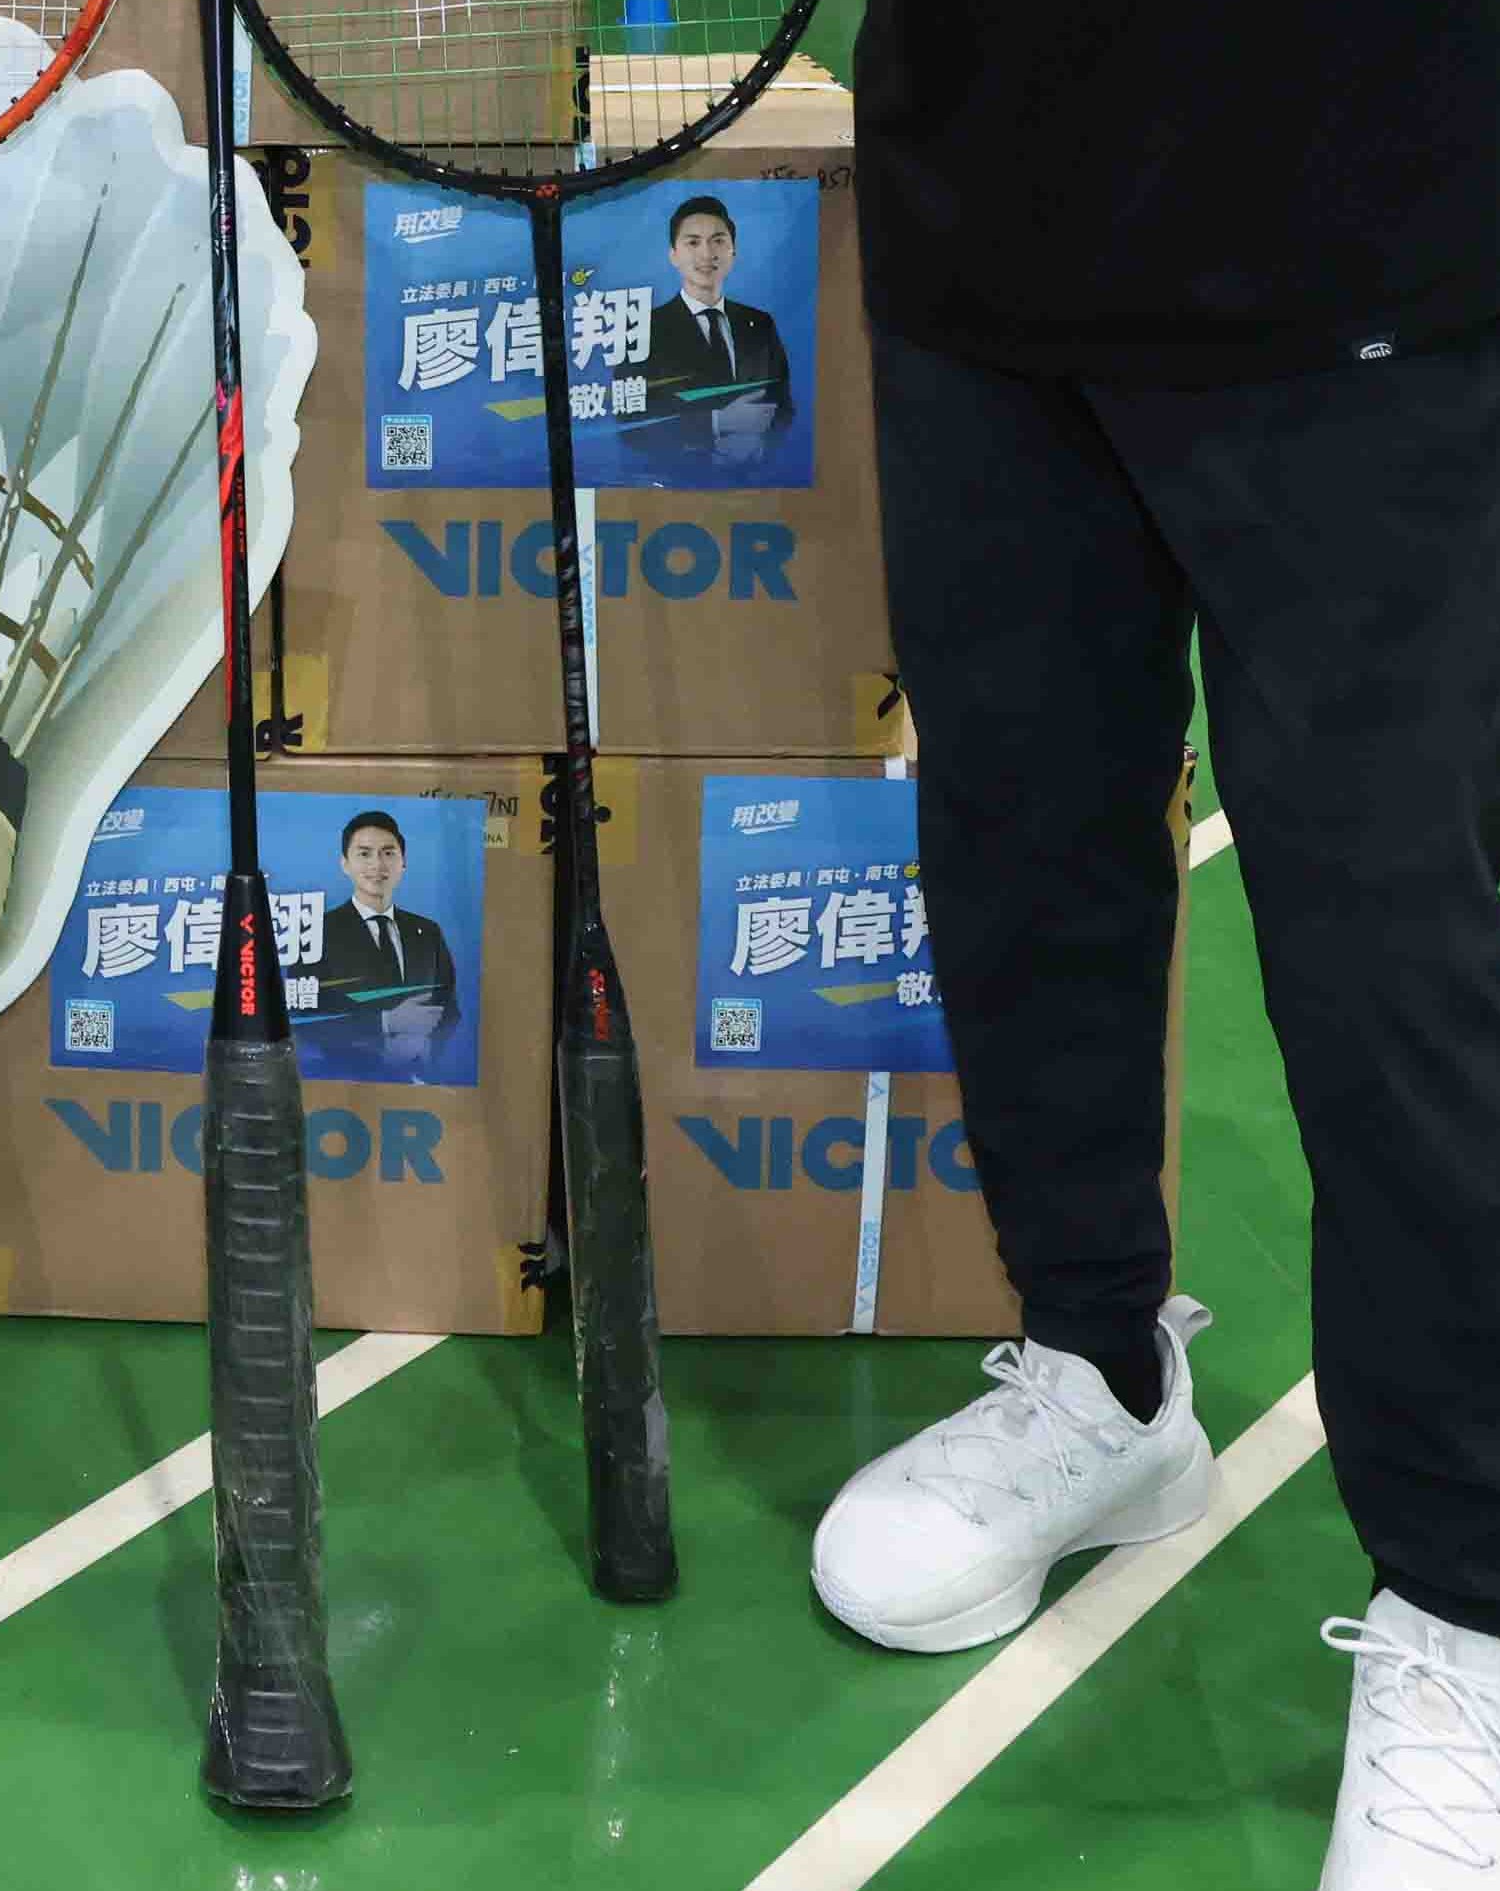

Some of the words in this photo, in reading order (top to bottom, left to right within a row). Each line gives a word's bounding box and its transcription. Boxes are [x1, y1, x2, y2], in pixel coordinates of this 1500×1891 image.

[395, 206, 463, 238] 翔改變
[401, 281, 469, 305] 立法委員
[397, 286, 655, 393] 廖偉翔
[568, 375, 648, 420] 敬贈
[377, 519, 800, 602] VICTOR
[100, 808, 145, 833] 改變
[731, 800, 800, 829] 翔改變
[86, 878, 149, 897] 立法委員
[735, 871, 802, 892] 立法委員
[81, 890, 326, 979] 廖偉翔
[239, 938, 256, 1016] VICTOR
[284, 975, 321, 1011] 贈
[897, 969, 942, 1007] 敬
[43, 1098, 445, 1185] VICOR
[676, 1116, 984, 1193] VICTO
